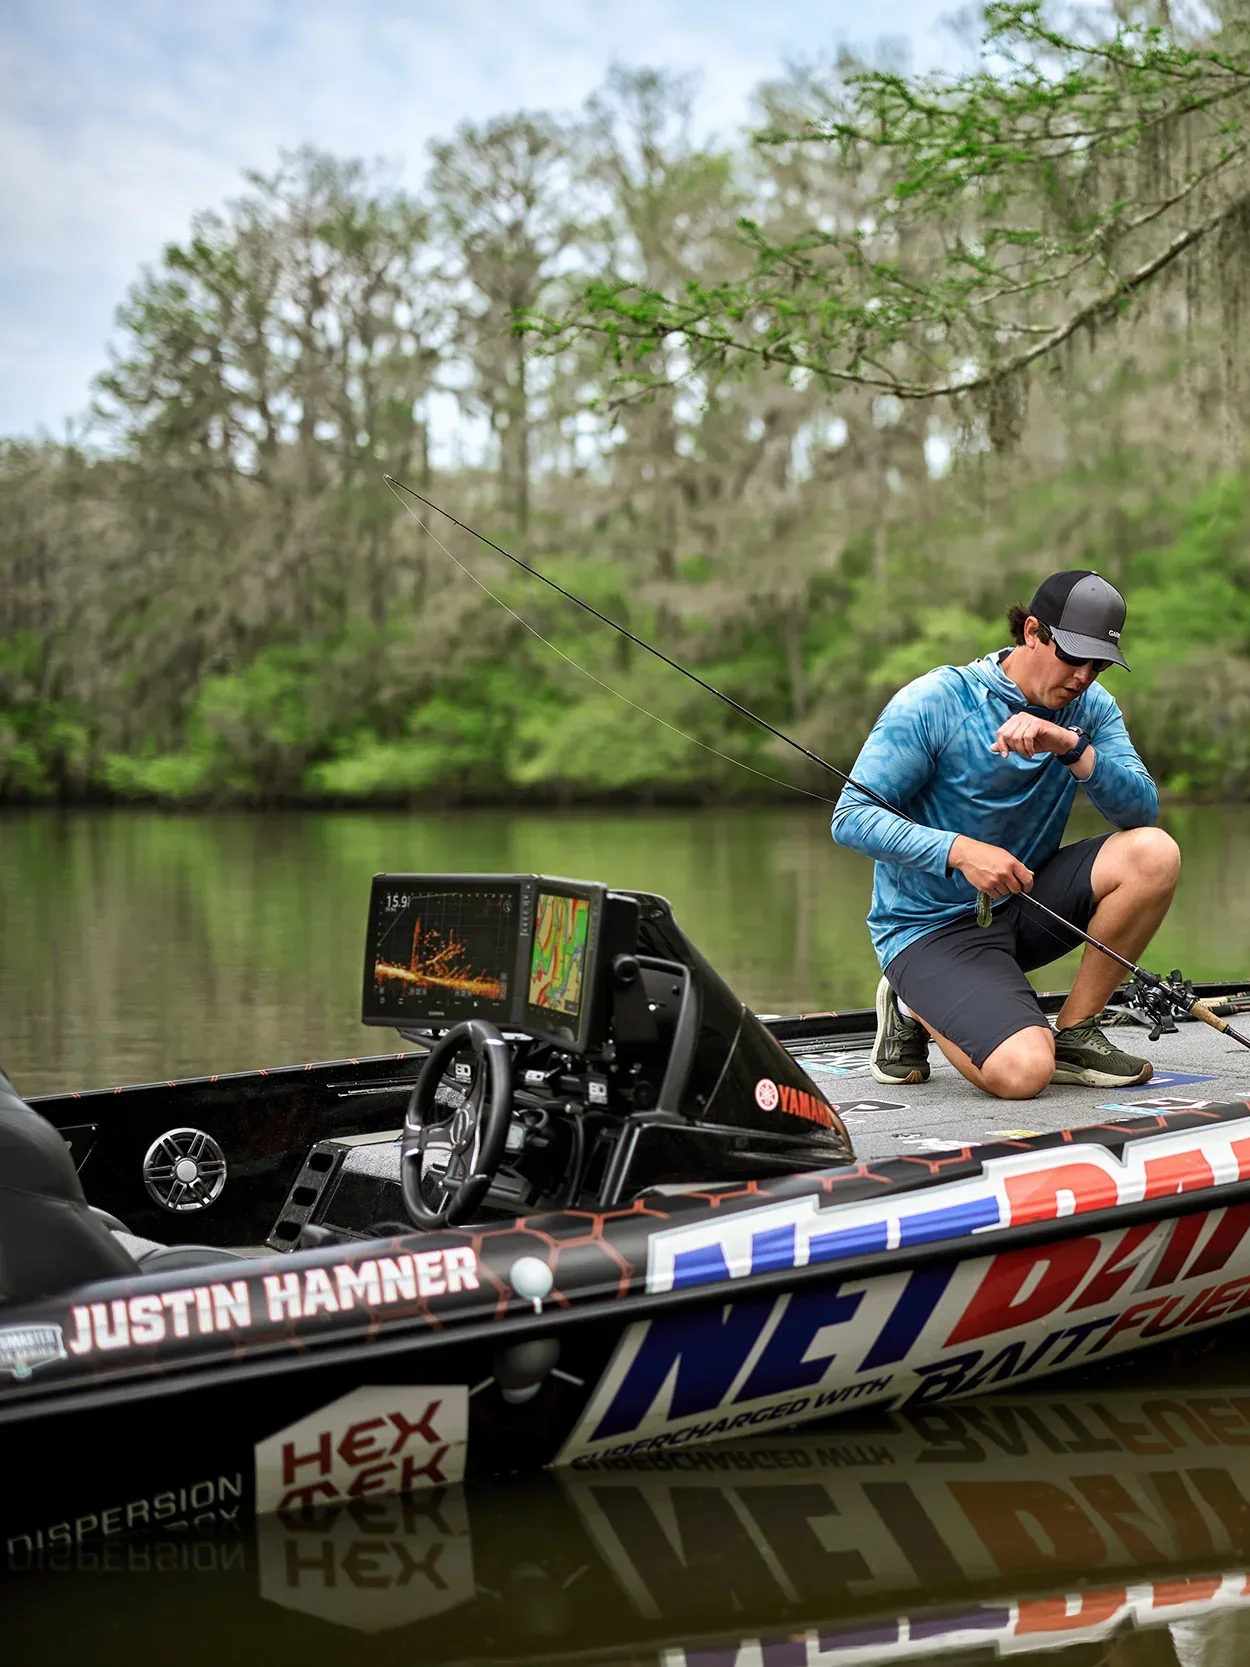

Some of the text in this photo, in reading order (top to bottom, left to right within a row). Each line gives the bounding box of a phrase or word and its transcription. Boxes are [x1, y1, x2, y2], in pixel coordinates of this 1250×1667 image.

[69, 1246, 480, 1355] JUSTIN HAMNER
[814, 1375, 895, 1409] WITH
[282, 1399, 443, 1487] HEX
[7, 1471, 243, 1555] DISPERSION
